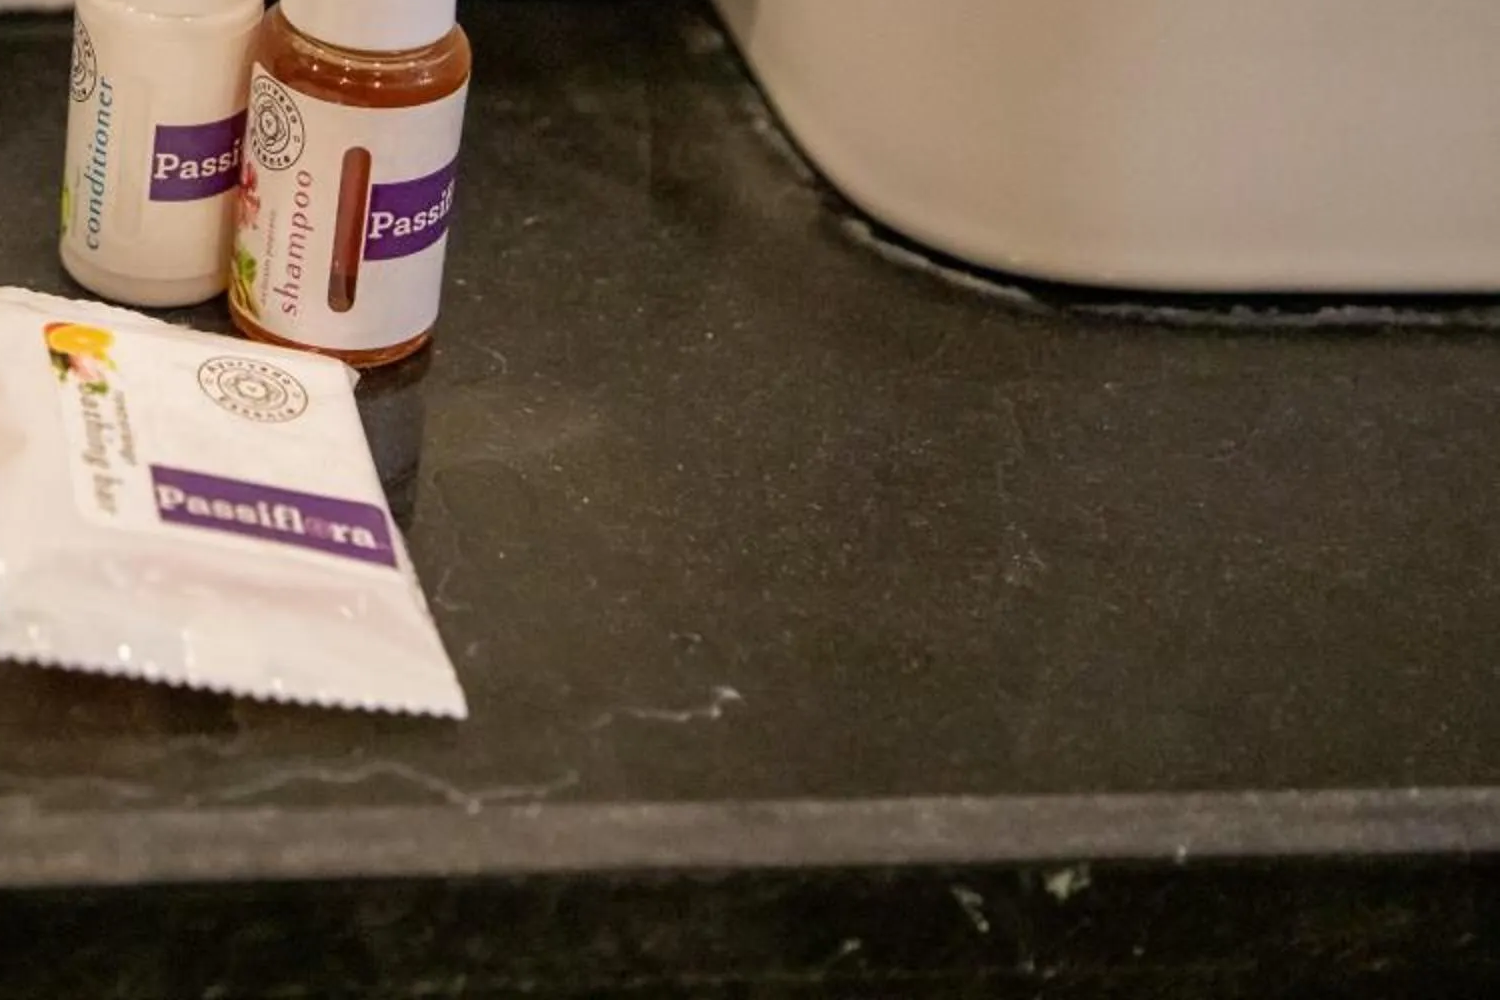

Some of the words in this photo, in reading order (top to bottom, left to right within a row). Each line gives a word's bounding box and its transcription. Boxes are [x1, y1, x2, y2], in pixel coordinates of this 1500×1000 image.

[84, 75, 114, 251] conditioner
[273, 169, 314, 316] shampoo
[156, 484, 377, 549] Passiflora
